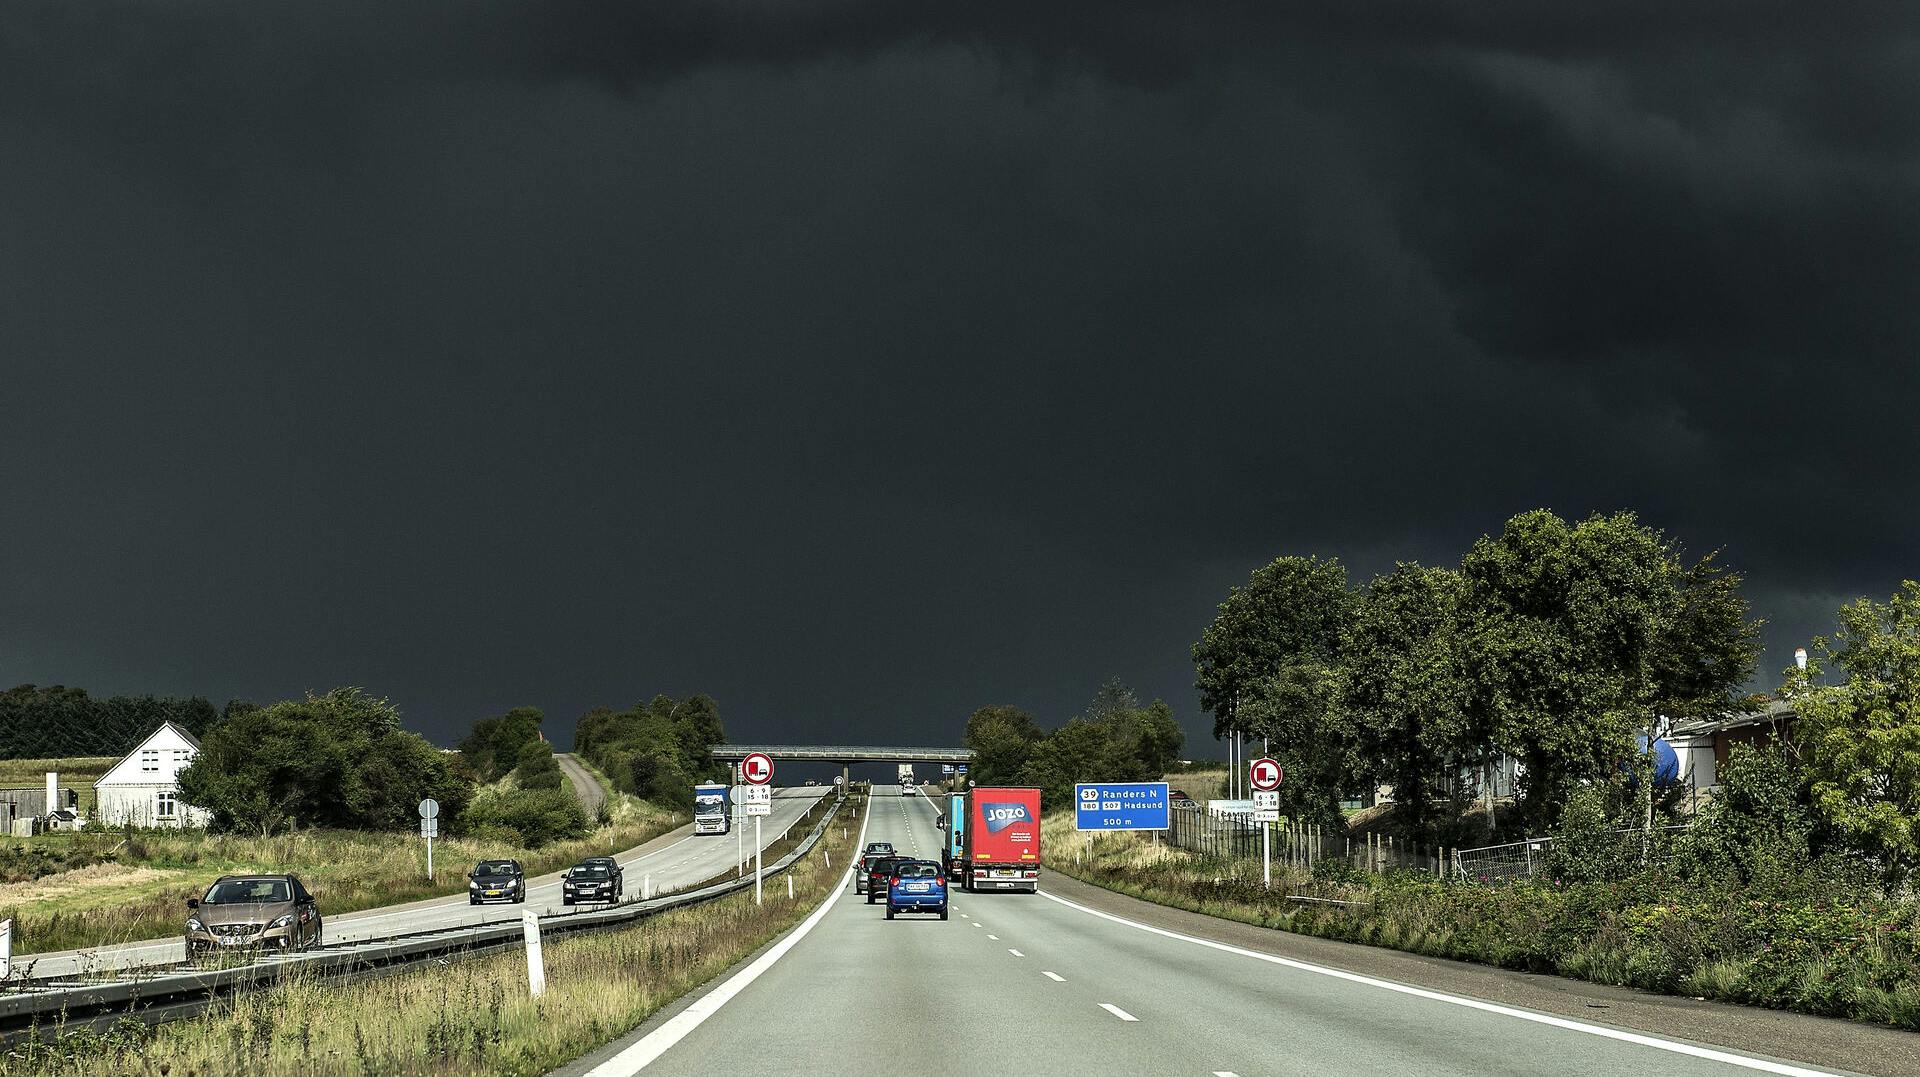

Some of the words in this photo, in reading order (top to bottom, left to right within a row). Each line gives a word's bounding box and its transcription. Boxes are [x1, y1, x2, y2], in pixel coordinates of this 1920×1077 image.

[1124, 801, 1163, 809] Hadsund
[988, 807, 1026, 822] JOZO
[1103, 818, 1122, 826] 500
